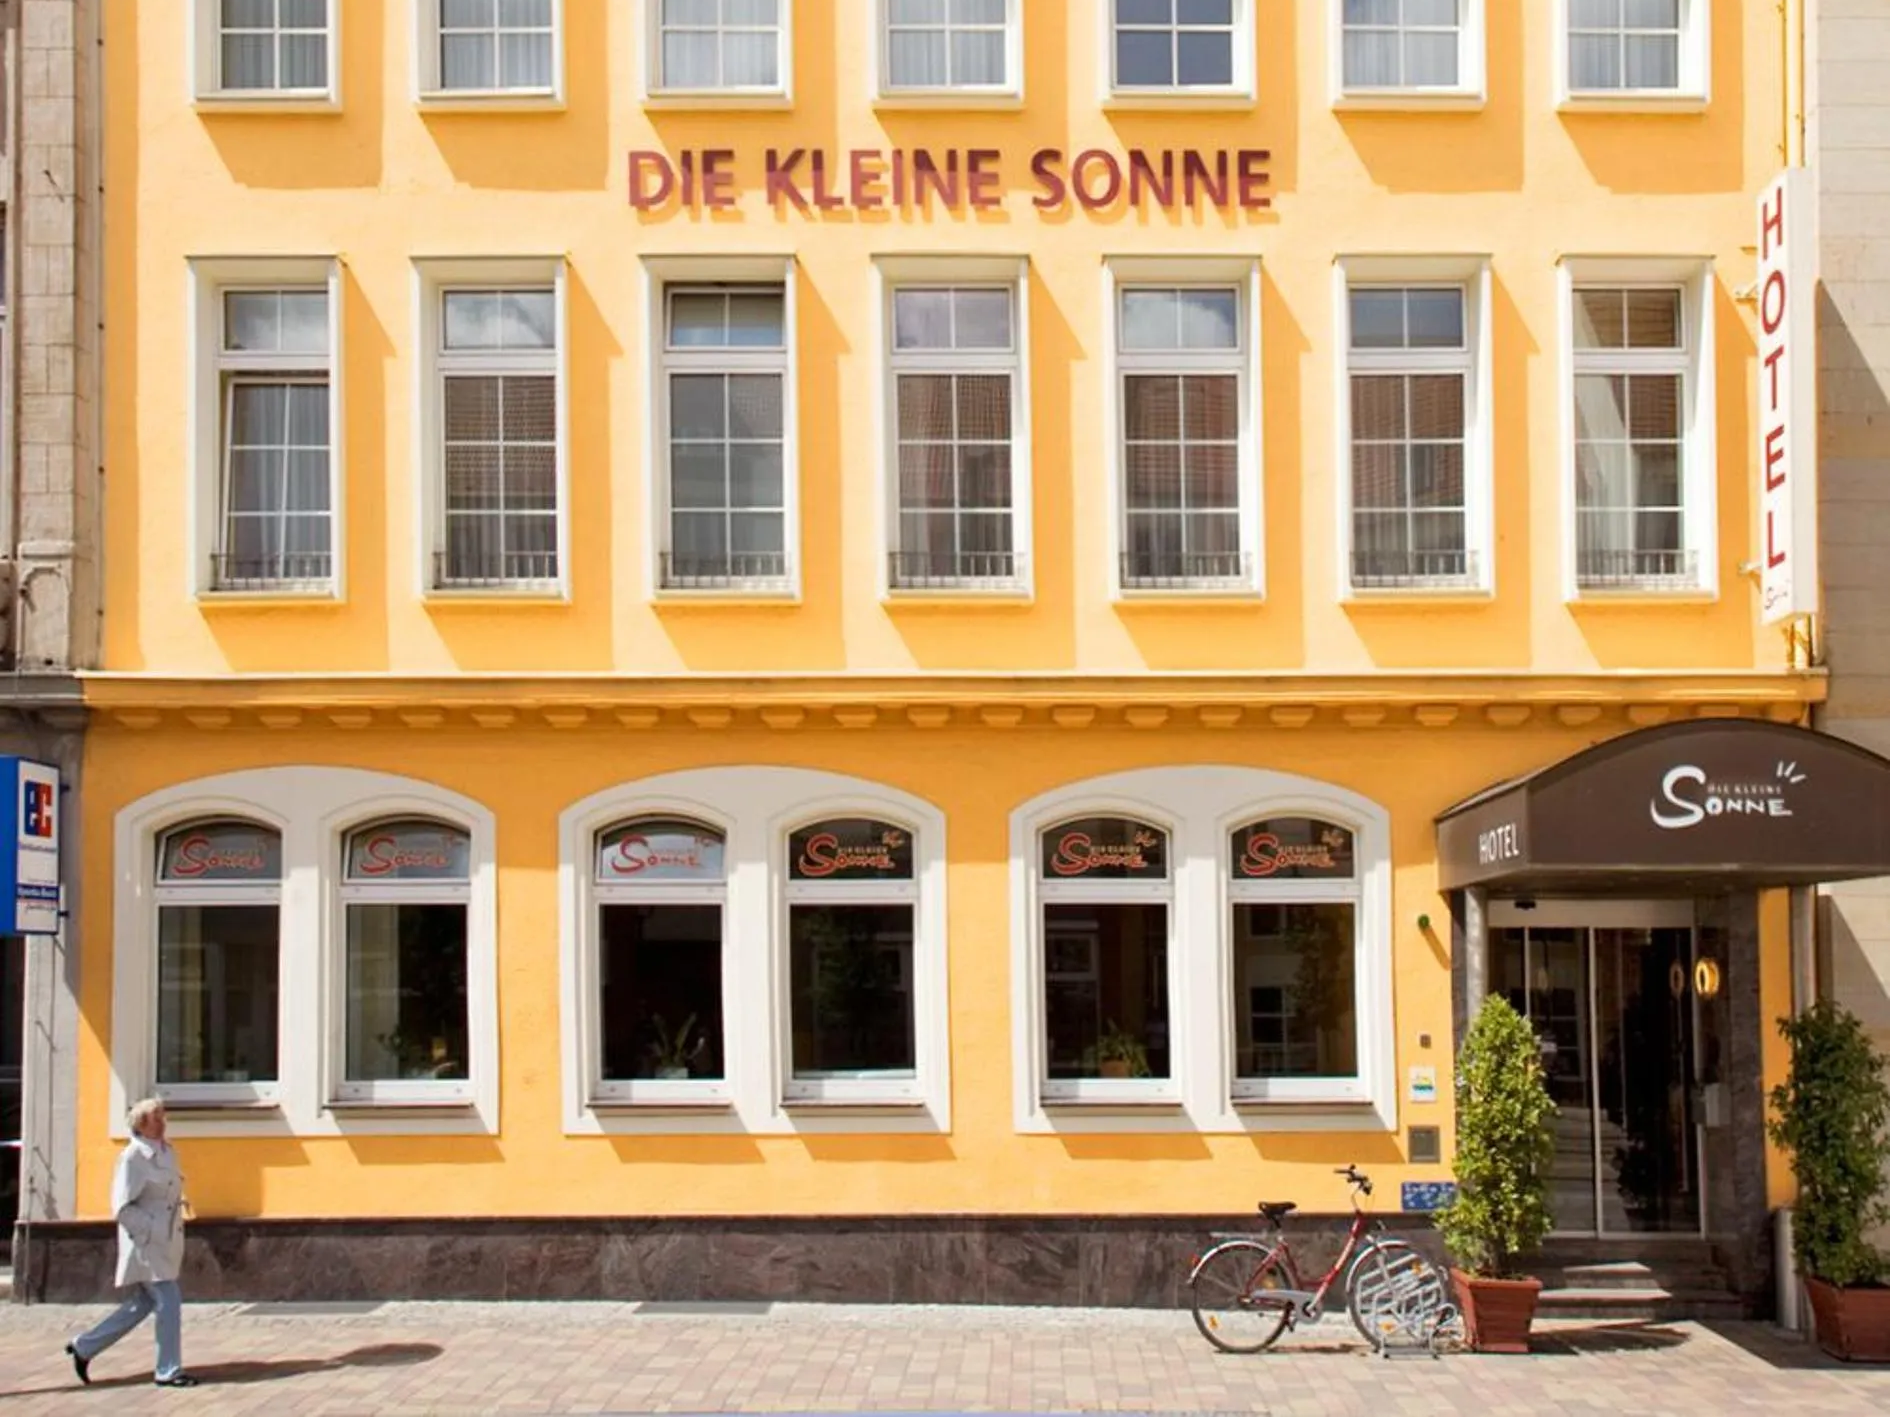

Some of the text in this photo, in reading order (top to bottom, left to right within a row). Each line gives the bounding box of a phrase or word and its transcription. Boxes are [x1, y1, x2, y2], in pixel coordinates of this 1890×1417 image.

[628, 148, 1271, 208] DIE KLEINE SONNE
[1762, 186, 1786, 569] HOTEL
[1479, 822, 1520, 866] HOTEL
